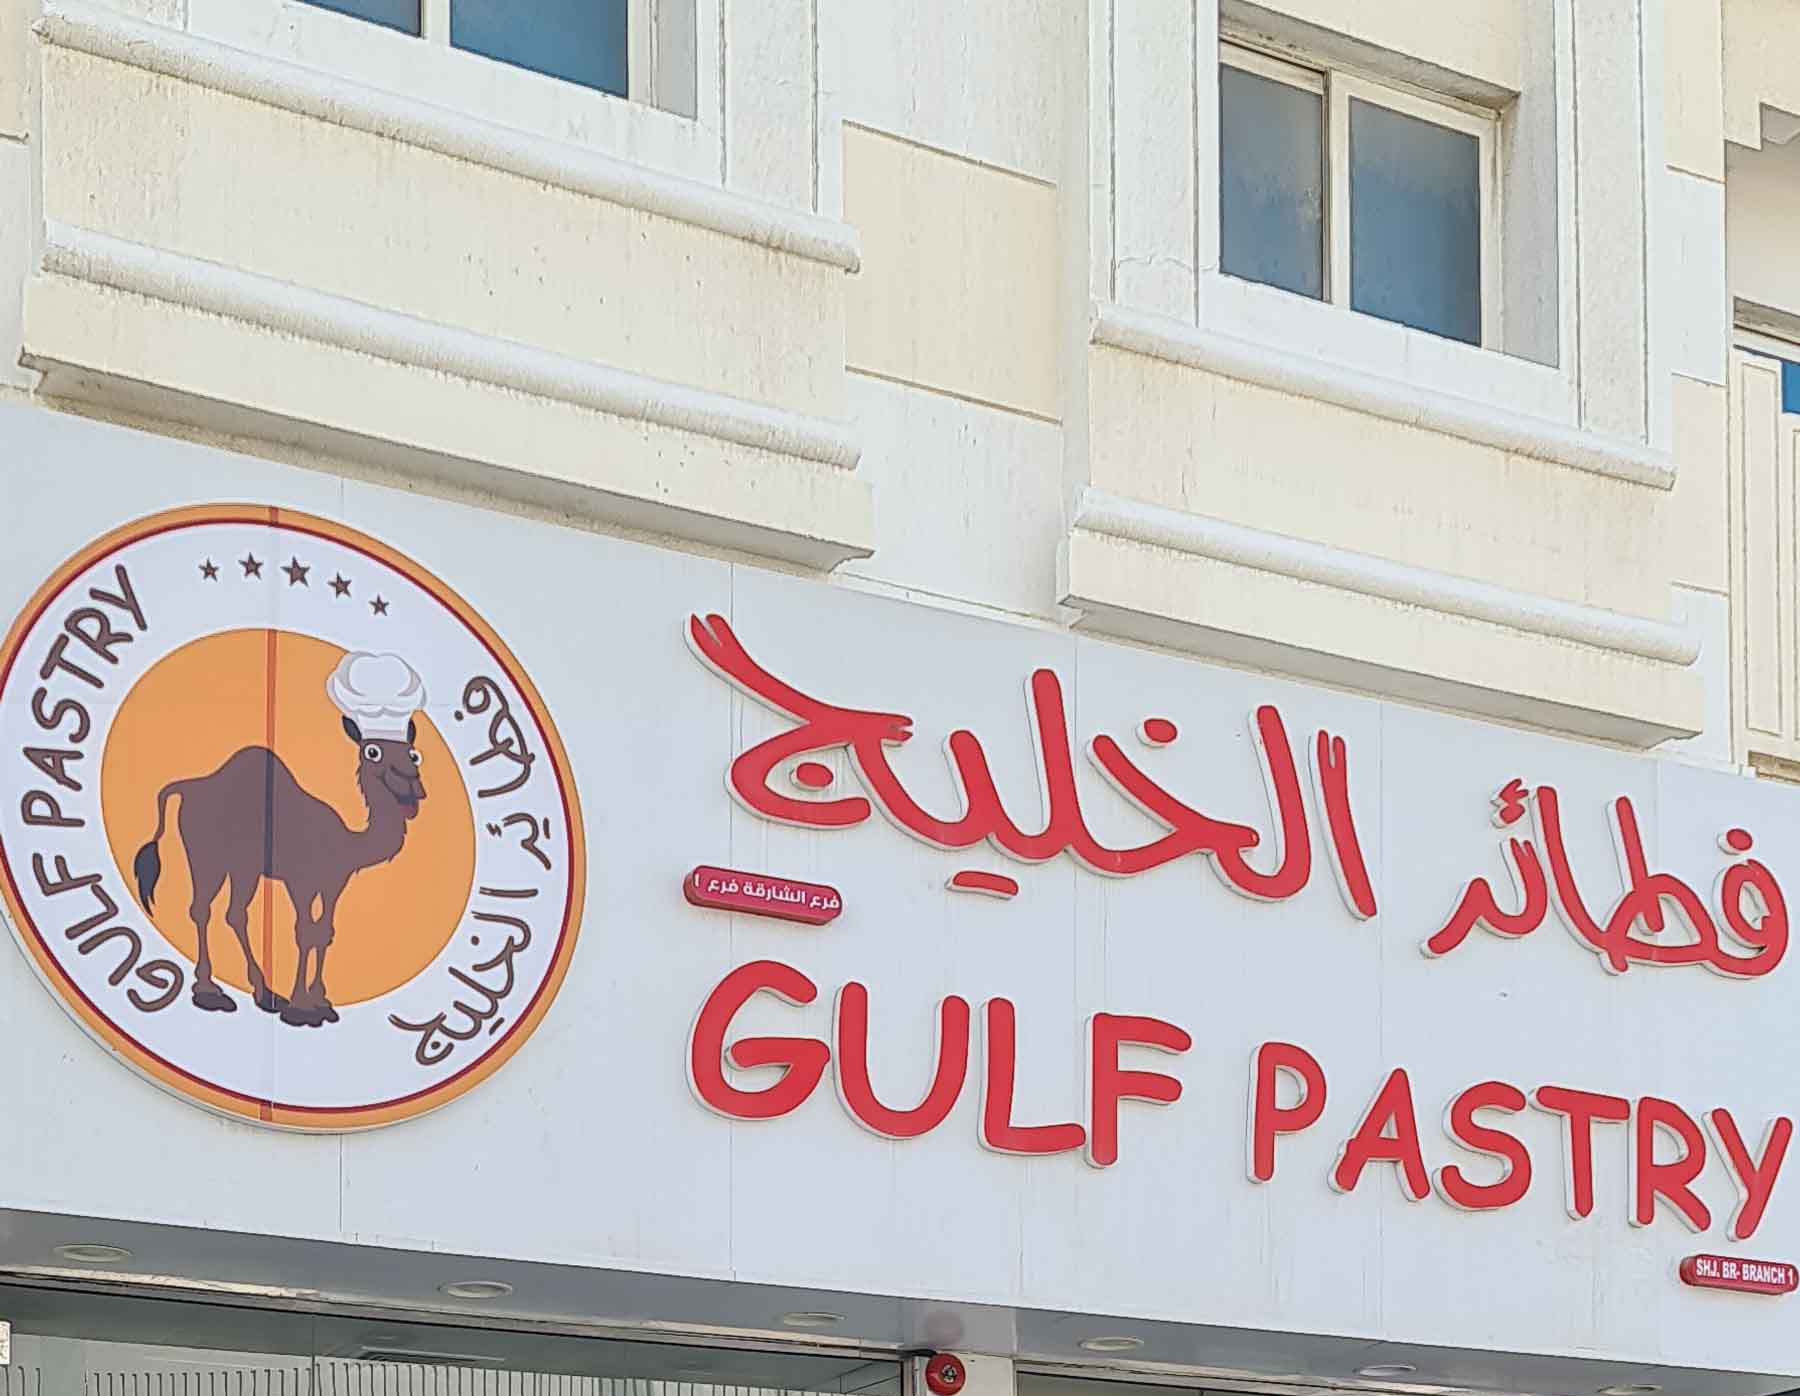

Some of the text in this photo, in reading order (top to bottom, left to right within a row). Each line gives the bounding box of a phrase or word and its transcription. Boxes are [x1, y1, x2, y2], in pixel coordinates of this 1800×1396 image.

[21, 564, 184, 1013] GULF PASTRY
[686, 612, 1790, 977] فطائر الخليج
[388, 675, 552, 1067] فطائر الخليج
[707, 876, 739, 894] فرع
[742, 881, 806, 905] الشارقة
[809, 894, 840, 910] فرع
[686, 958, 1794, 1241] GULF PASTRY
[1695, 1258, 1721, 1278] SHJ.
[1742, 1263, 1786, 1285] BRANCH
[1788, 1267, 1794, 1286] 1
